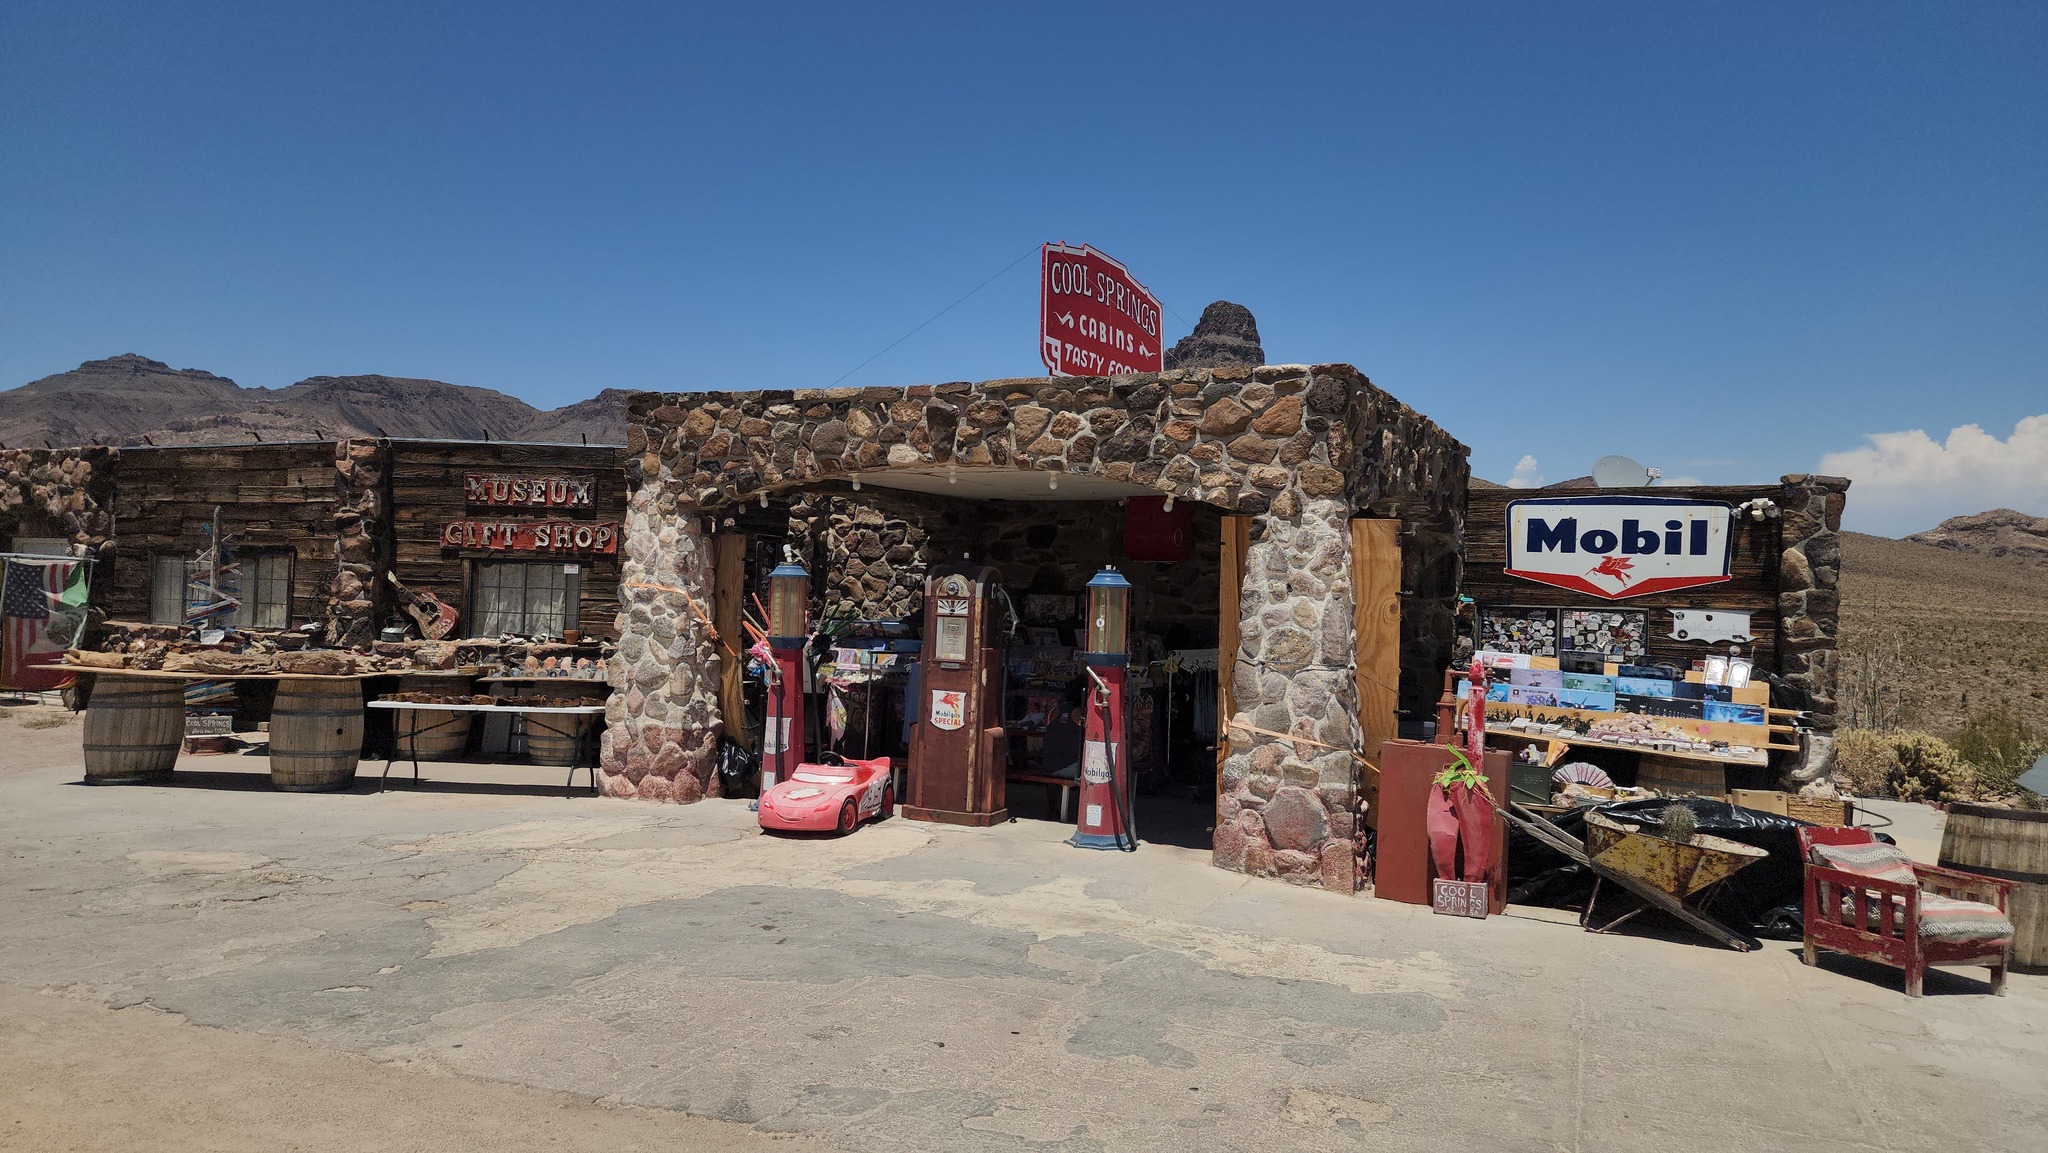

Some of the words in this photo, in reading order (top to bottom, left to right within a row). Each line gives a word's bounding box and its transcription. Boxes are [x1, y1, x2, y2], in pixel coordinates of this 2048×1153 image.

[1051, 262, 1092, 297] COOL
[1097, 272, 1157, 337] SPRINGS
[1079, 314, 1134, 353] CABINS
[1065, 342, 1105, 374] TASTY
[468, 477, 590, 504] MUSEUM
[445, 522, 518, 546] GIFT
[535, 524, 612, 549] SHOP
[1526, 518, 1708, 555] Mobil
[934, 716, 962, 726] SPECIAL
[1440, 885, 1477, 898] COOL
